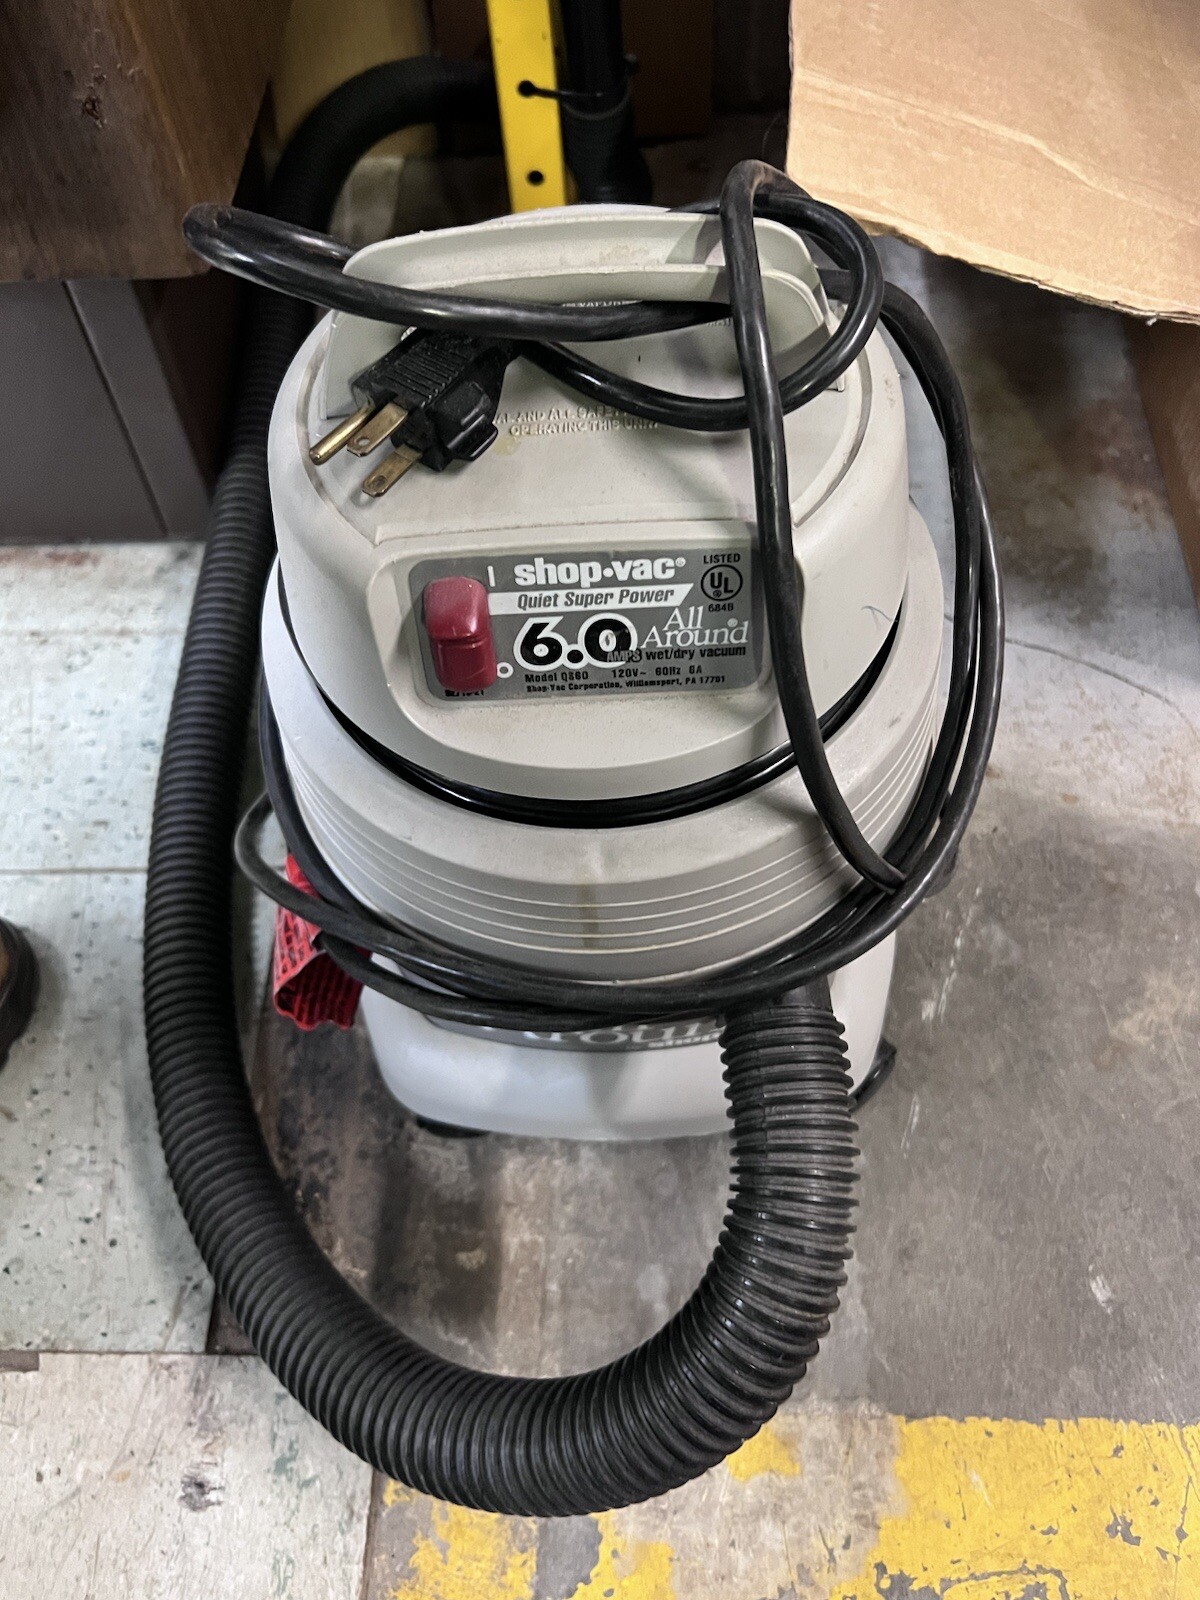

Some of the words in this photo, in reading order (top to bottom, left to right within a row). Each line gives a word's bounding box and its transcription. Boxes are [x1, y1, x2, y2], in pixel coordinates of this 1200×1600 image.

[589, 418, 620, 432] THIS
[703, 553, 741, 564] LISTED
[710, 571, 734, 594] UL
[517, 593, 559, 610] Quiet
[565, 591, 613, 608] Super
[618, 589, 675, 604] Power
[662, 605, 704, 631] All
[513, 612, 638, 672] 6.0
[606, 650, 642, 663] AMPS
[645, 648, 695, 661] wet/dry
[700, 646, 746, 658] vacuum
[525, 673, 557, 683] Model
[685, 677, 696, 685] PA
